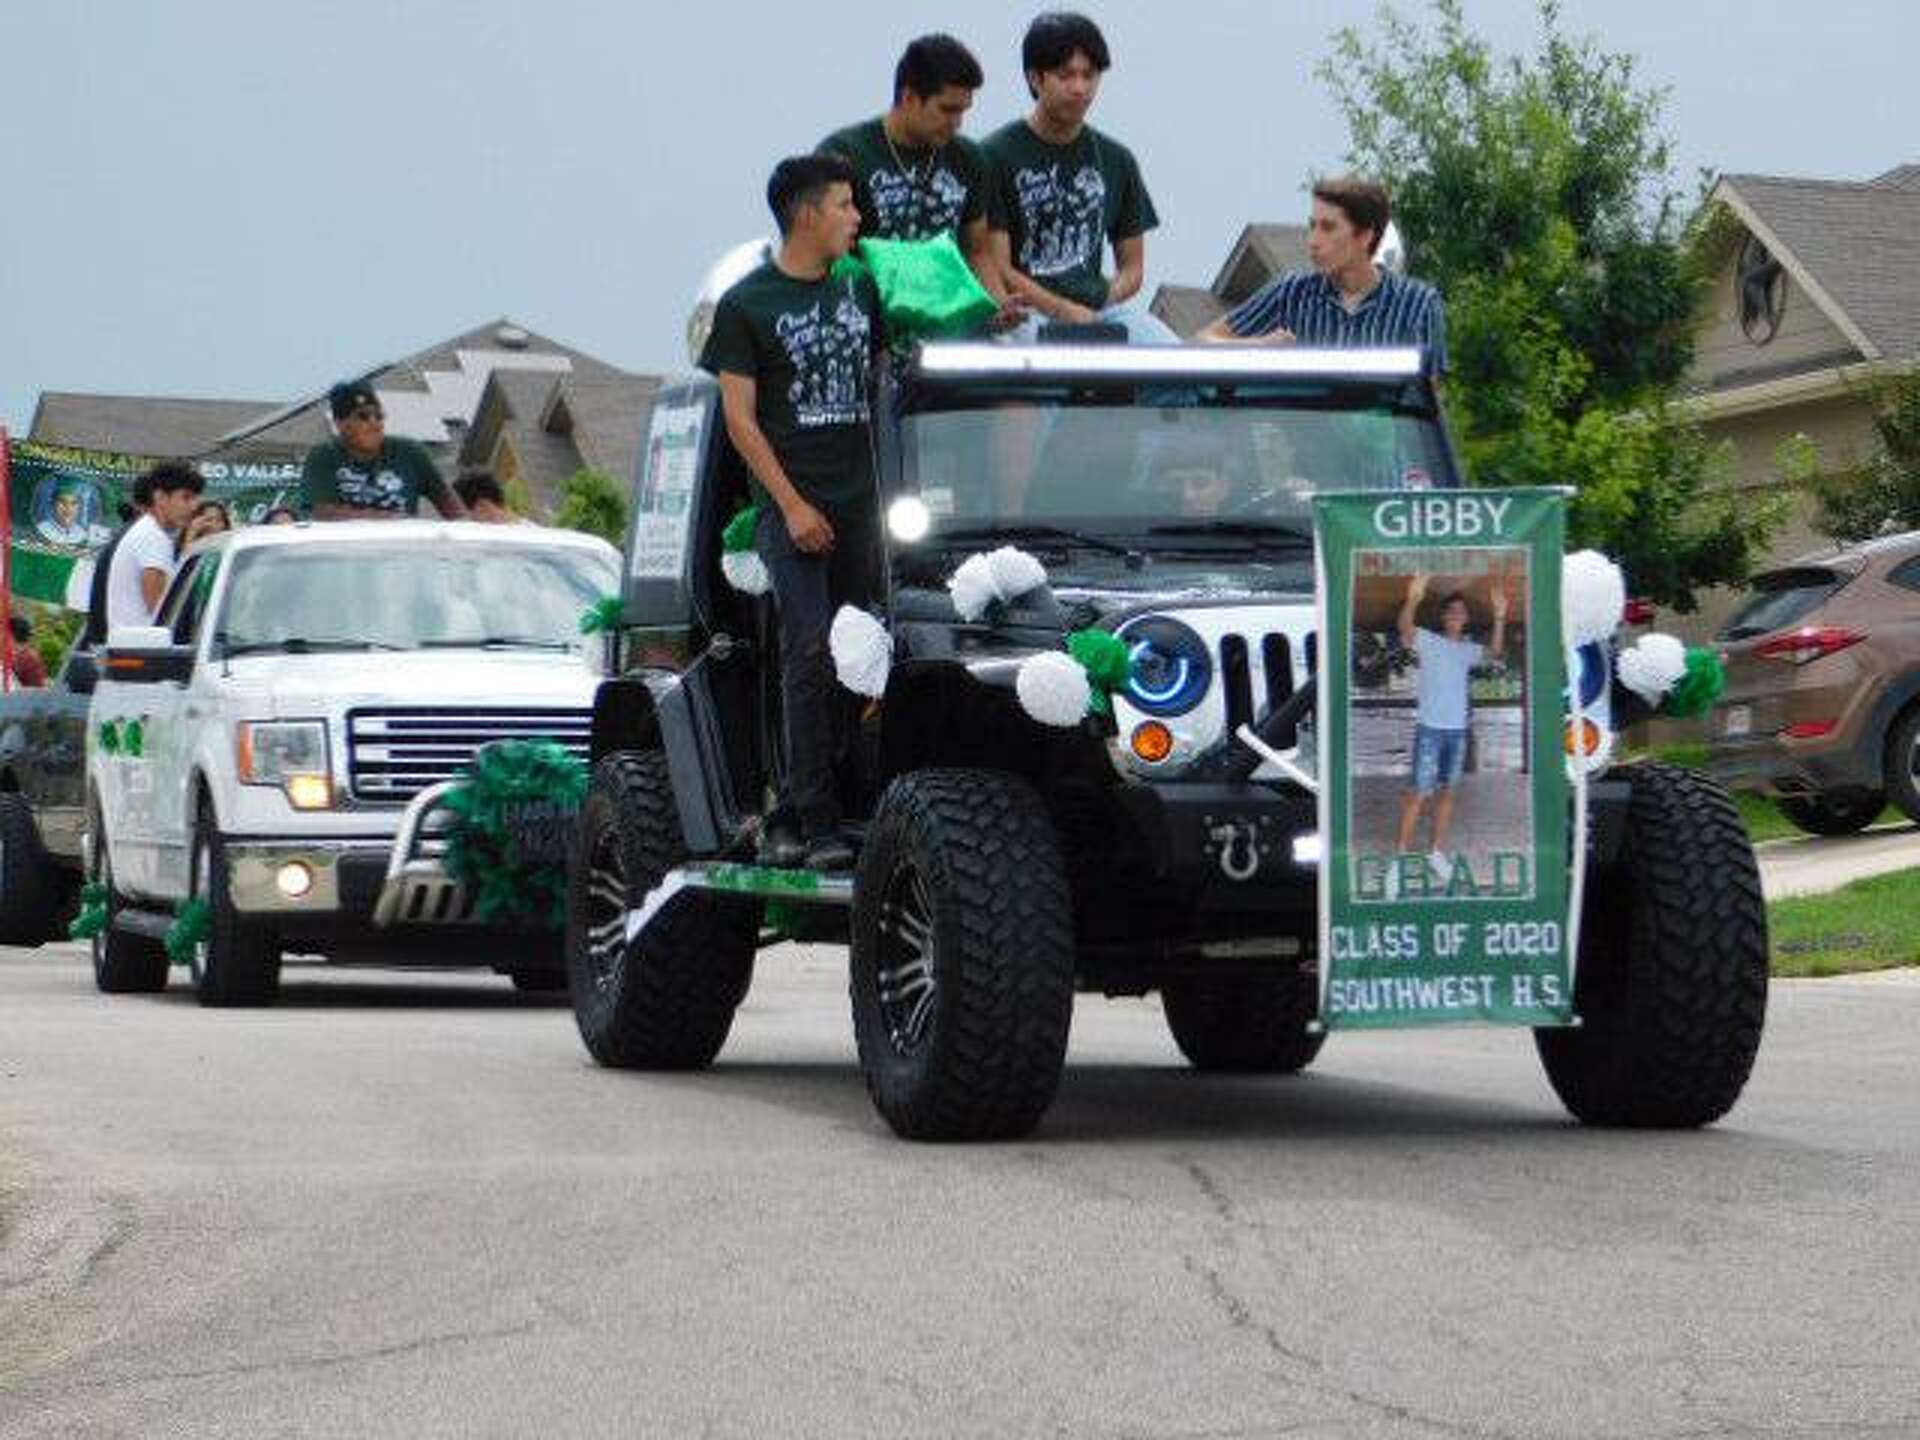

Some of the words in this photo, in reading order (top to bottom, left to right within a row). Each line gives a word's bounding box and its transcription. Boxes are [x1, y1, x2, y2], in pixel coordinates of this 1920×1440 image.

[1373, 497, 1513, 538] GIBBY
[1330, 924, 1419, 960] CLASS
[1433, 923, 1470, 957] OF
[1484, 921, 1562, 957] 2020
[1329, 974, 1496, 1013] SOUTHWEST
